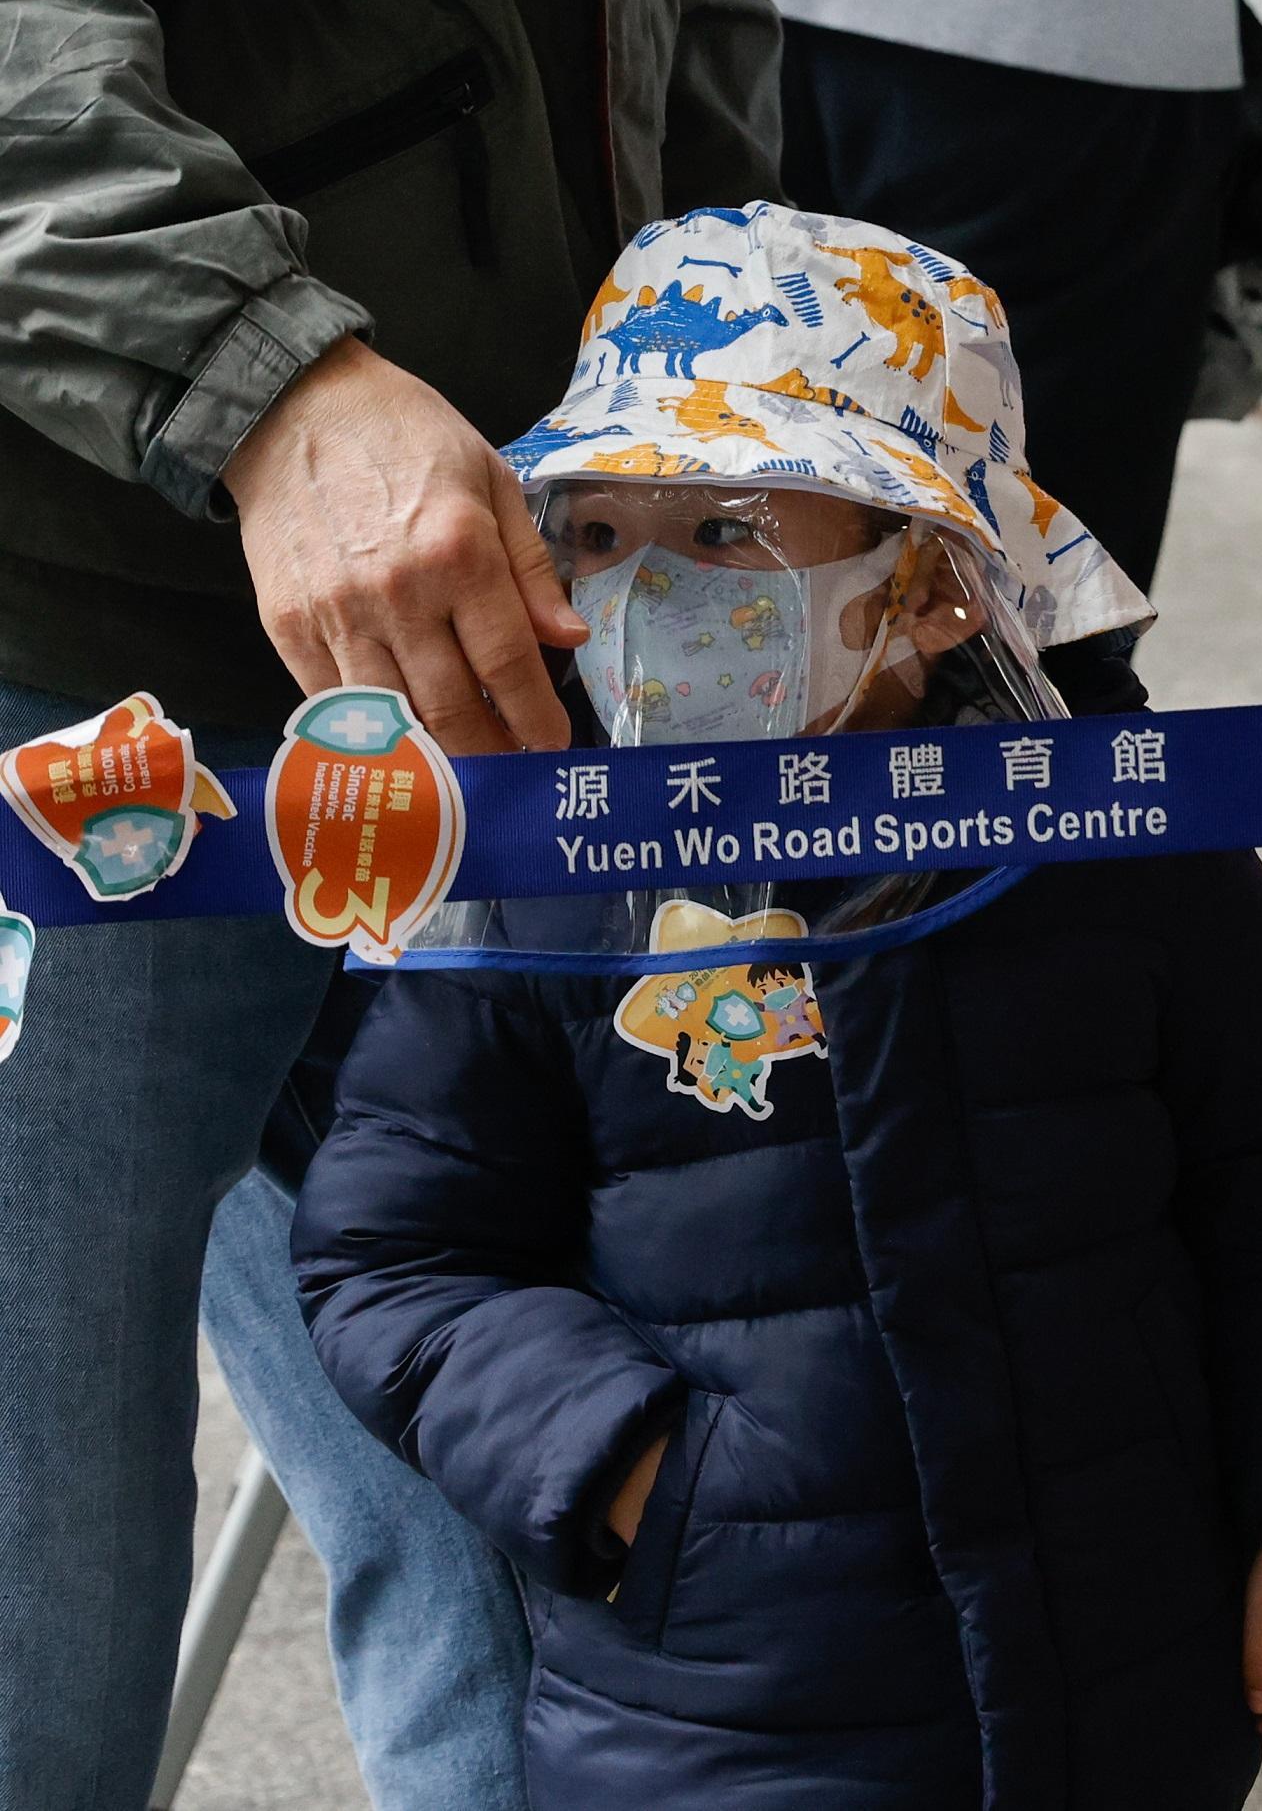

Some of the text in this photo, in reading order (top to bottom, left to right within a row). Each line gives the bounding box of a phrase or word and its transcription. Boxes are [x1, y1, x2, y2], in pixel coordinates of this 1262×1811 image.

[325, 763, 346, 821] CoronaVac
[342, 765, 366, 822] Sinovac
[385, 769, 415, 812] 科興
[555, 729, 1168, 821] 源禾路體育館
[303, 761, 330, 867] Inactivated Vaccine
[556, 795, 1168, 874] Yuen Wo Road Sports Centre
[299, 867, 390, 940] 3
